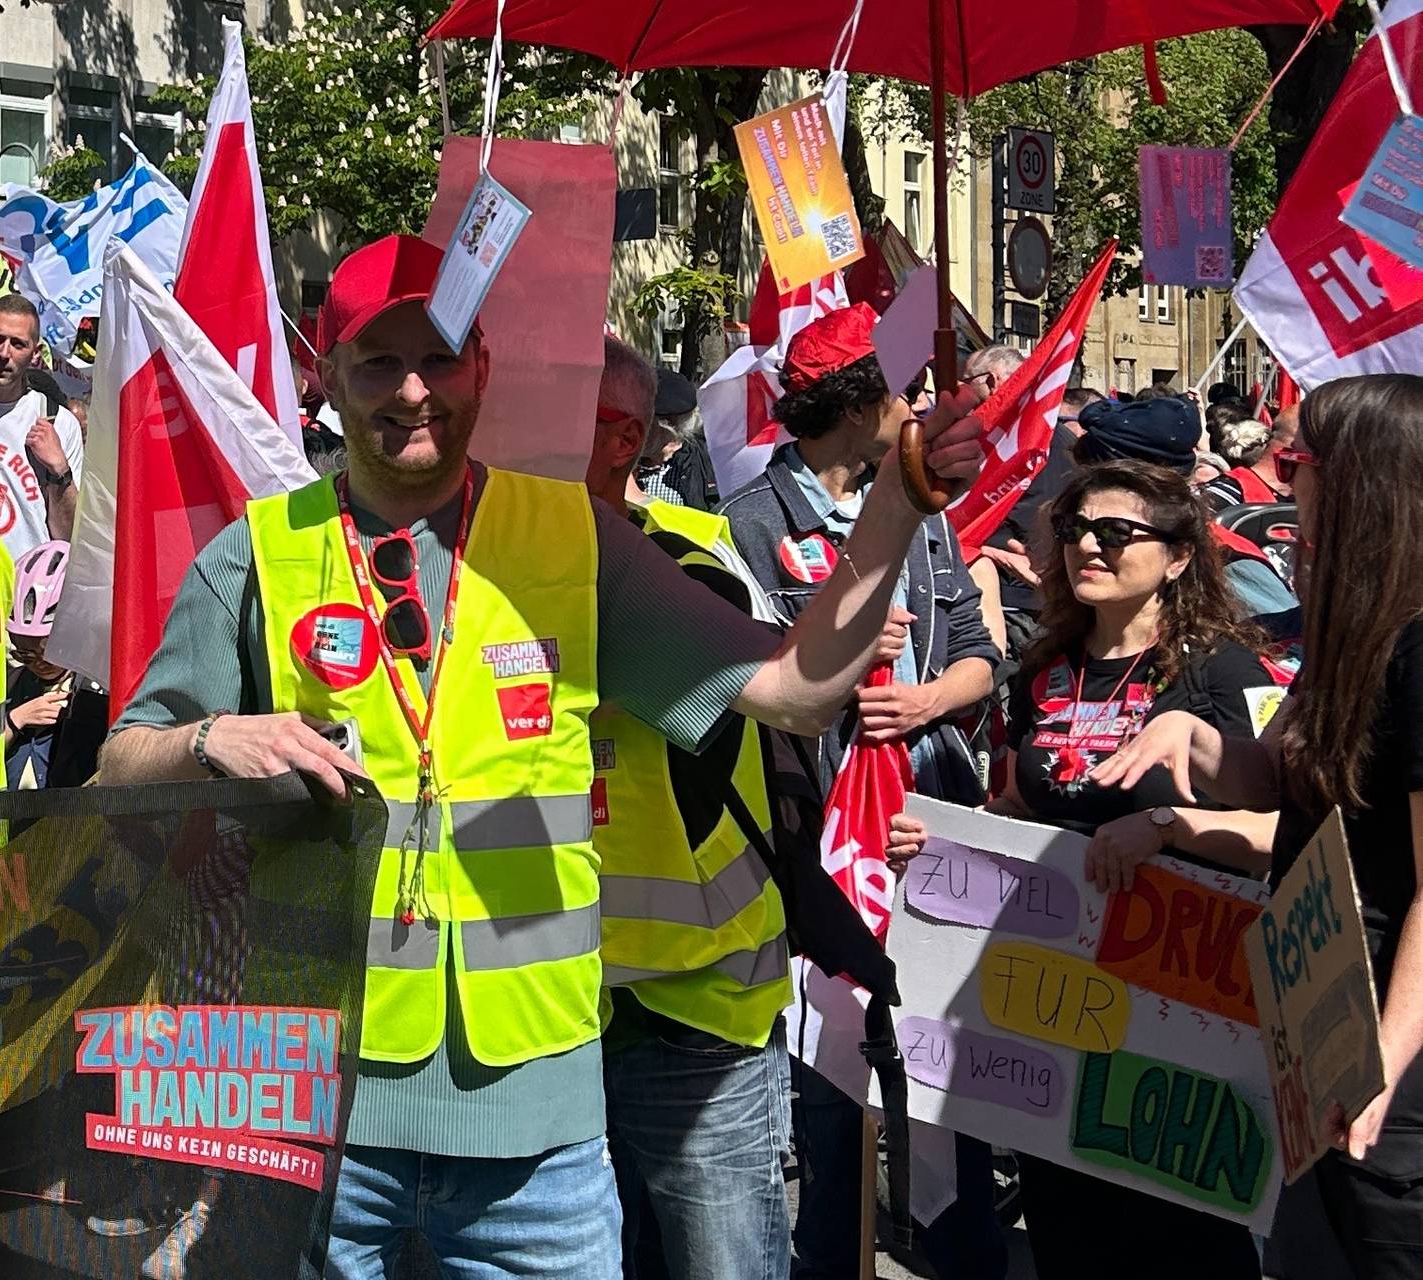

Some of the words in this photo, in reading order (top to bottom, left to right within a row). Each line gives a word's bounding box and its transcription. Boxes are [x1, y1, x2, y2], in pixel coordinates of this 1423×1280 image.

[1022, 149, 1041, 175] 30
[1020, 191, 1044, 208] ZONE
[7, 454, 40, 503] RICH
[481, 638, 558, 662] ZUSAMMEN
[494, 654, 560, 678] HANDELN
[918, 853, 969, 899] ZU
[998, 867, 1064, 920] VIEL
[1095, 882, 1264, 1006] DRUC
[80, 1010, 337, 1074] ZUSAMMEN
[907, 1030, 948, 1069] ZU
[120, 1070, 339, 1139] HANDELN
[1078, 1050, 1265, 1205] LOHN
[93, 1123, 137, 1146] OHNE
[141, 1129, 174, 1152] UNS
[177, 1135, 222, 1158] KEIN
[226, 1143, 317, 1179] GESCHÄFT!
